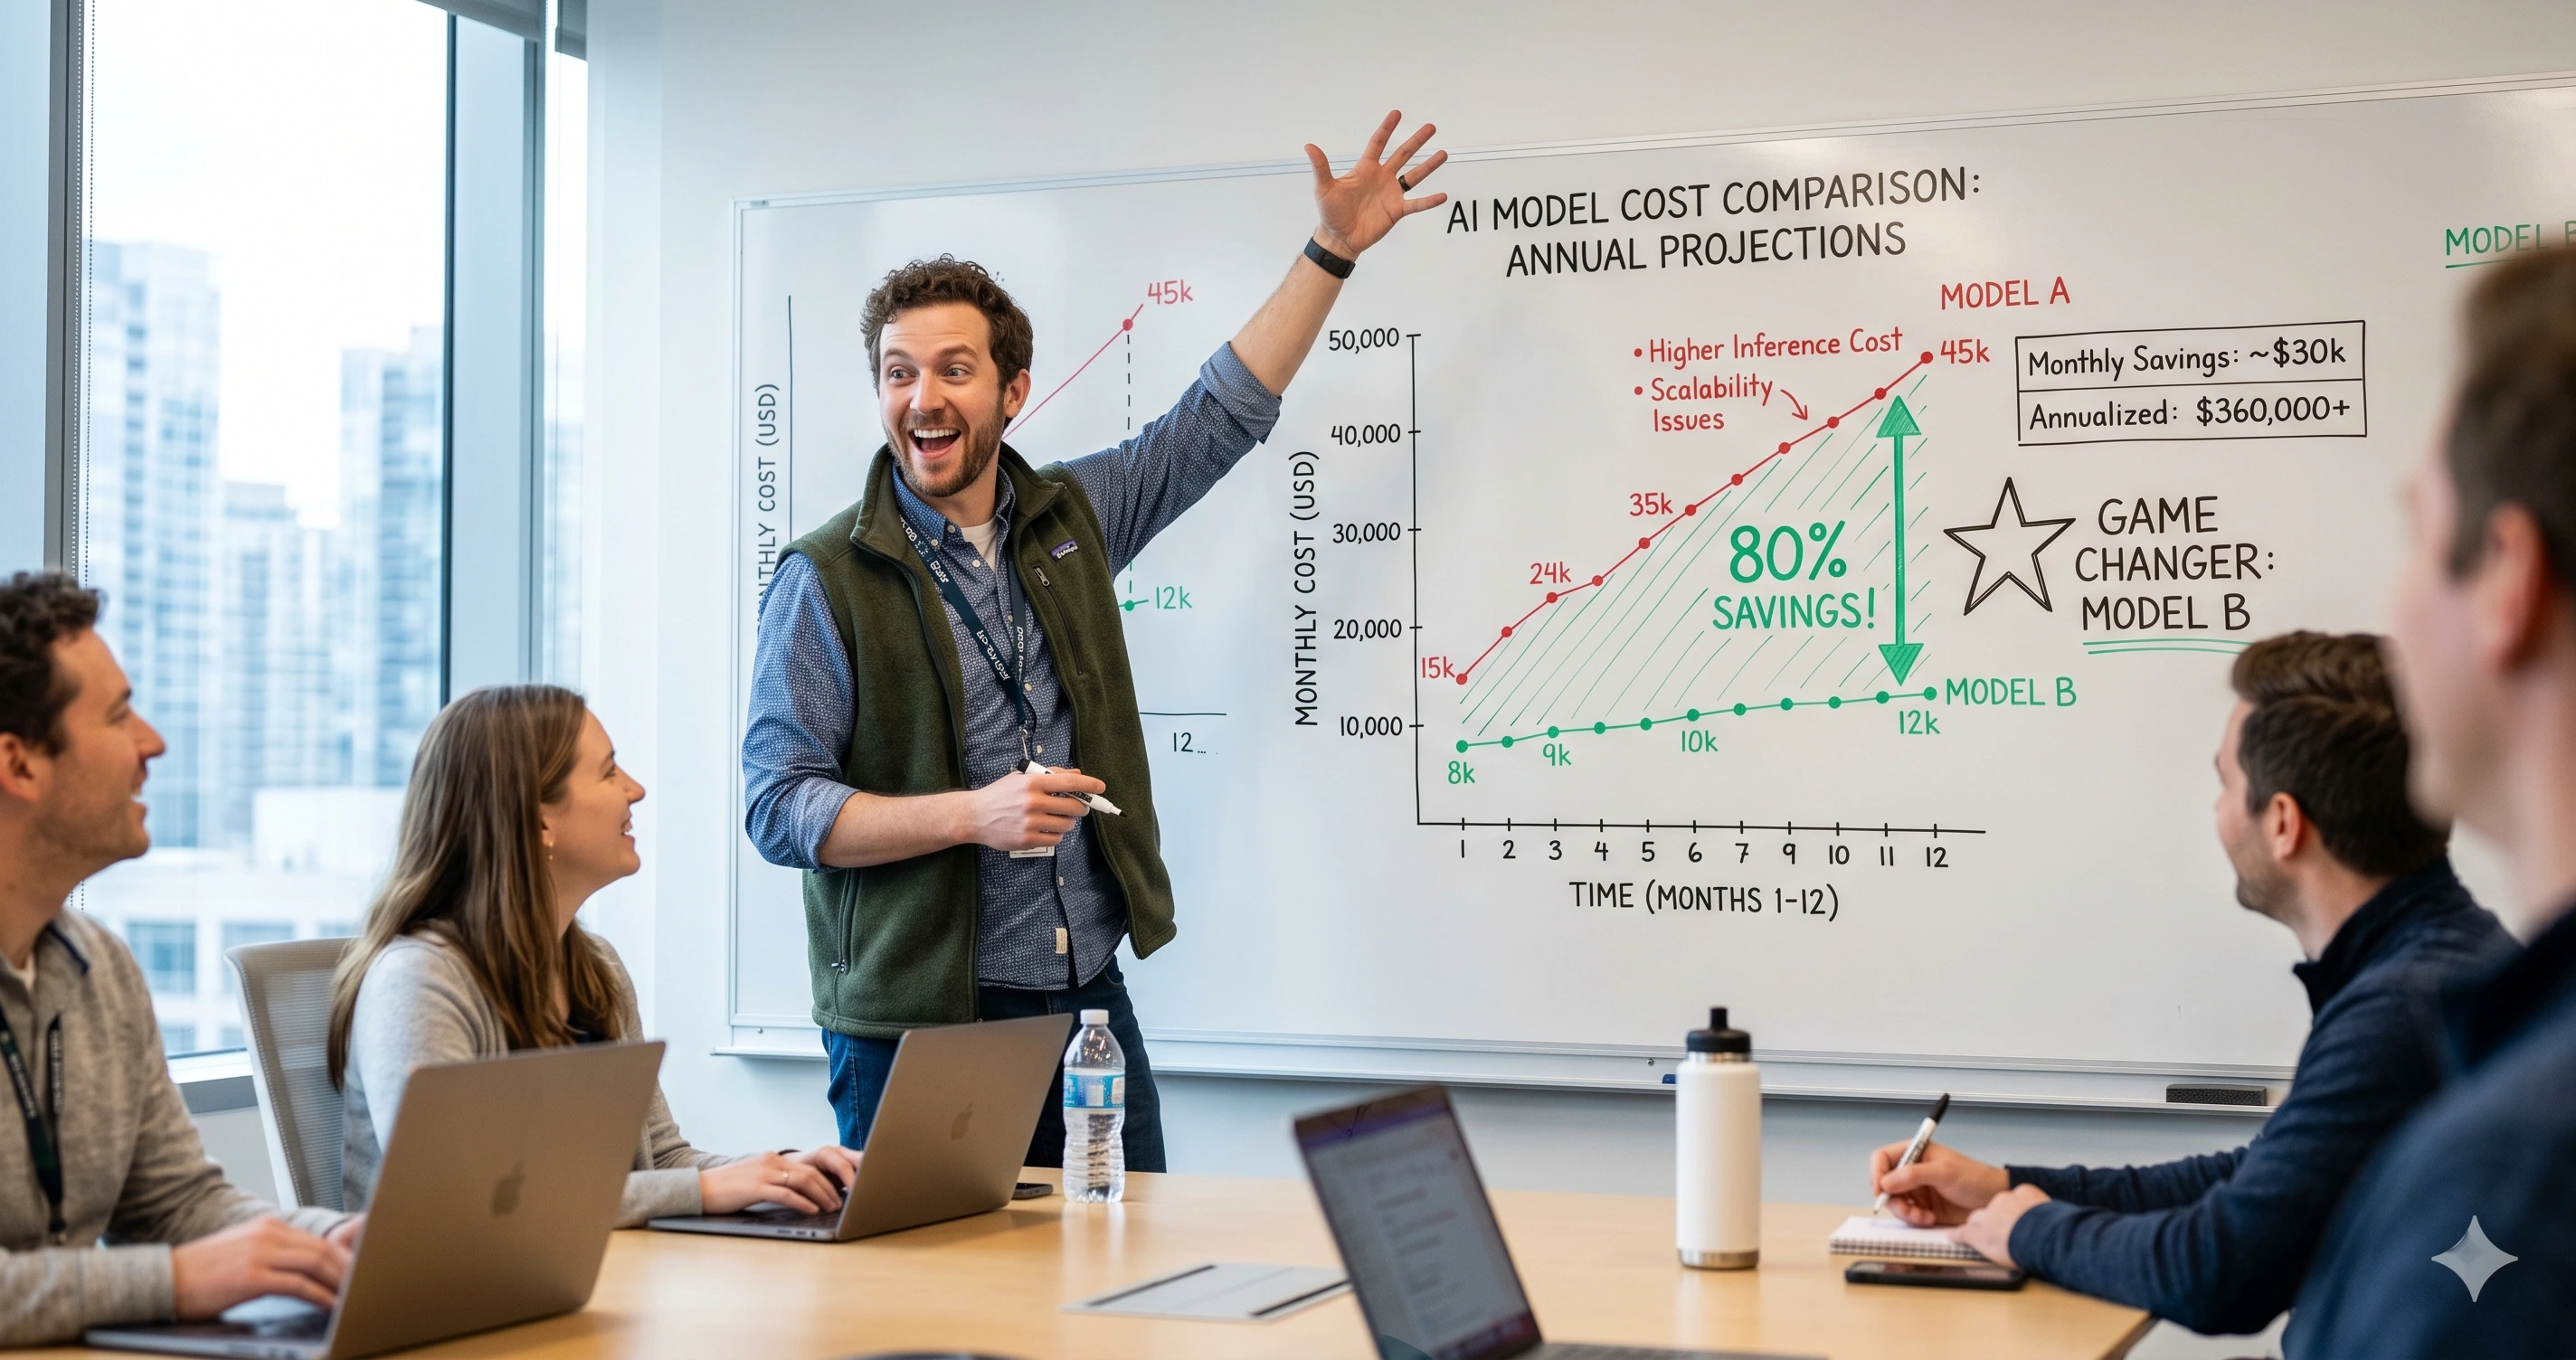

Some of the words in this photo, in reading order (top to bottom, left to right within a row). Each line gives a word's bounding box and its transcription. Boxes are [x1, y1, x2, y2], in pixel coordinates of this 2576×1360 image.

[1447, 199, 1478, 234] AI
[1492, 191, 1610, 231] MODEL
[1620, 184, 1710, 222] COST
[1722, 165, 1980, 215] COMPARISON:
[1505, 237, 1648, 279] ANNUAL
[1659, 221, 1907, 269] PROJECTIONS
[2445, 222, 2552, 256] MODEL
[1147, 279, 1194, 305] 45k
[1941, 279, 2040, 311] MODEL
[2049, 276, 2071, 305] A
[1328, 326, 1400, 354] 50,000
[1650, 336, 1725, 370] Higher
[1733, 332, 1842, 359] Inference
[1849, 326, 1904, 353] Cost
[1939, 338, 1991, 364] 45k
[2029, 346, 2125, 382] Monthly
[2133, 345, 2239, 379] Savings:
[2249, 335, 2347, 367] ~$30k
[1651, 373, 1774, 406] Scalability
[753, 383, 781, 447] (USD)
[1653, 408, 1725, 433] Issues
[2029, 398, 2178, 430] Annualized:
[2195, 395, 2351, 428] $360,000+
[1331, 422, 1401, 449] 40,000
[757, 456, 776, 513] COST
[1287, 450, 1321, 521] (USD)
[1629, 492, 1674, 517] 35k
[2098, 496, 2219, 536] GAME
[1332, 521, 1401, 545] 30,000
[1293, 530, 1316, 594] COST
[1728, 518, 1848, 584] 80%
[2075, 543, 2274, 582] CHANGER:
[1530, 561, 1572, 585] 24k
[1155, 585, 1193, 610] 12k
[1711, 587, 1877, 630] SAVINGS!
[2082, 595, 2209, 631] MODEL
[2223, 592, 2251, 631] B
[1332, 619, 1403, 643] 20,000
[1293, 604, 1319, 726] MONTHLY
[1421, 656, 1456, 679] 15k
[1946, 676, 2046, 706] MODEL
[2055, 675, 2078, 707] B
[1340, 715, 1403, 740] 10,000
[1899, 709, 1941, 735] 12k
[1542, 742, 1572, 767] 9k
[1681, 729, 1719, 753] 10k
[1447, 760, 1476, 785] 8k
[1459, 837, 1467, 861] 1
[1502, 839, 1517, 860] 2
[1548, 839, 1563, 861] 3
[1594, 840, 1609, 862] 4
[1641, 840, 1656, 863] 5
[1688, 841, 1703, 864] 6
[1734, 842, 1749, 864] 7
[1782, 842, 1796, 865] 9
[1828, 844, 1851, 865] 10
[1880, 845, 1895, 867] 11
[1926, 845, 1949, 868] 12
[1568, 881, 1634, 909] TIME
[1645, 878, 1763, 915] (MONTHS
[1775, 883, 1839, 922] 1-12)
